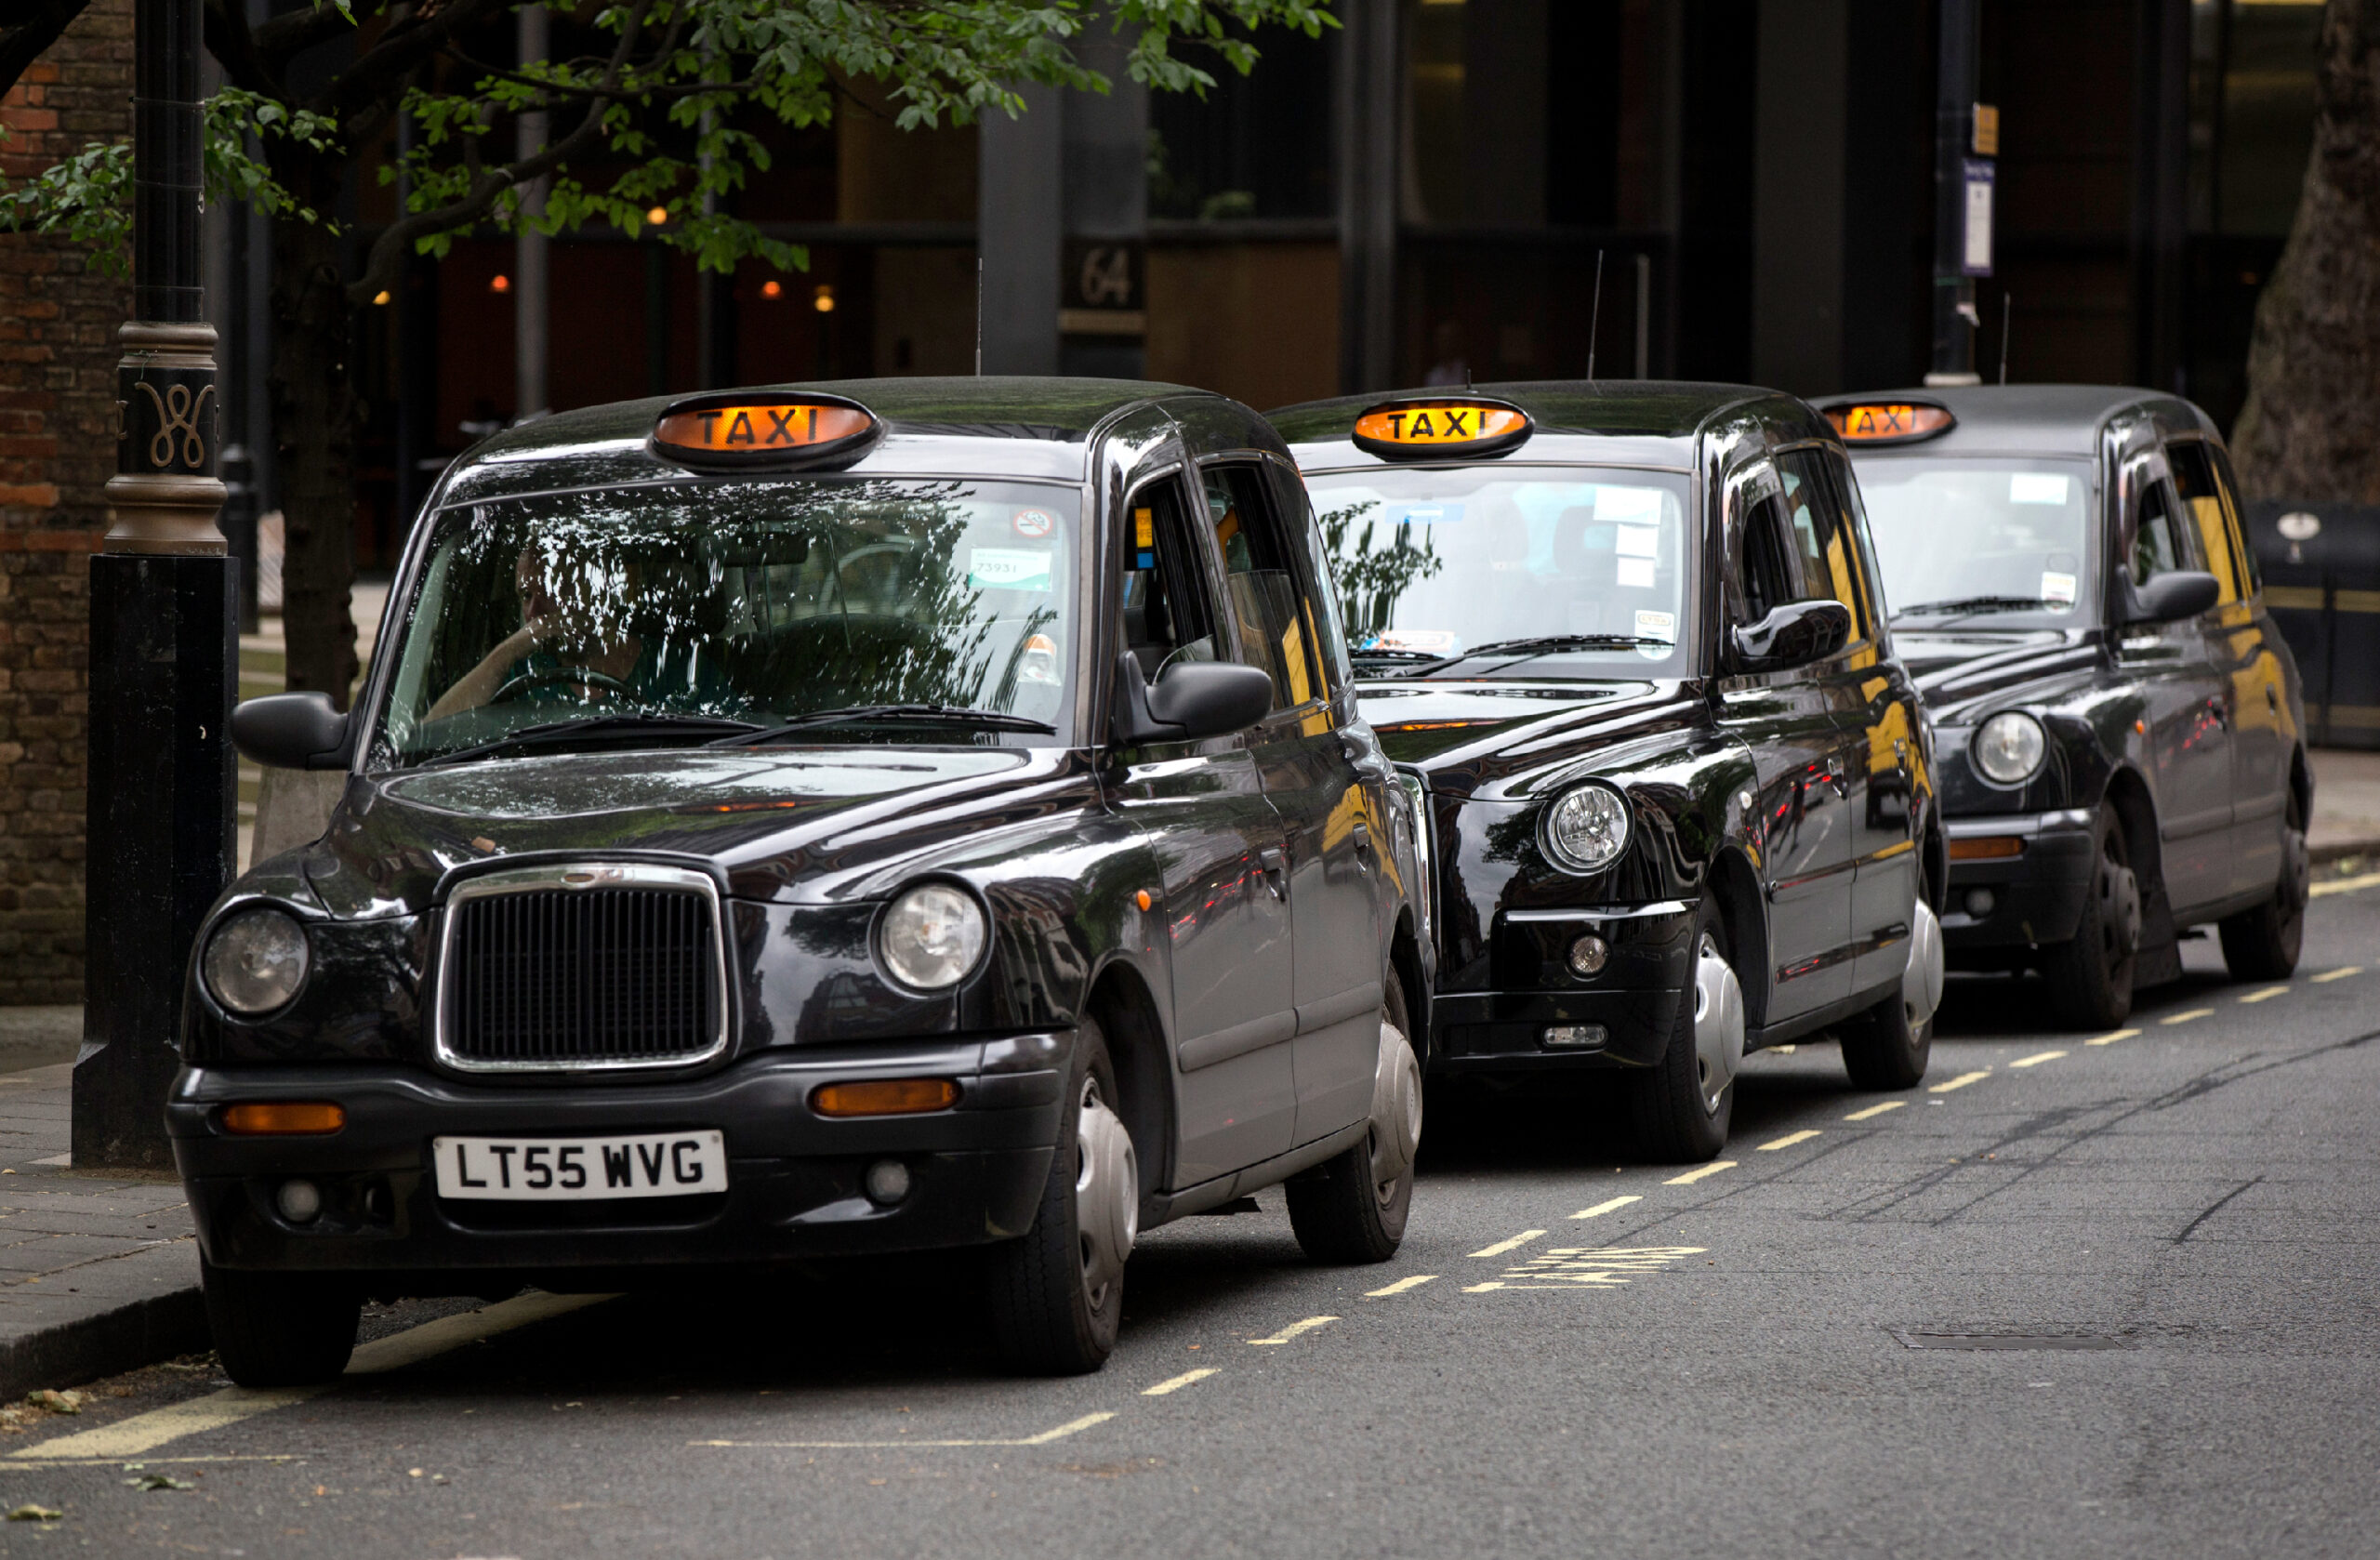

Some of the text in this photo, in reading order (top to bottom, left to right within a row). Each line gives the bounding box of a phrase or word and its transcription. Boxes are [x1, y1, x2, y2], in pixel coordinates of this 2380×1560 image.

[1082, 248, 1130, 304] 64
[697, 408, 818, 445] TAXI
[1388, 411, 1487, 440] TAXI
[1836, 406, 1917, 434] TAXI
[976, 562, 1017, 574] 73931
[456, 1141, 704, 1189] LT55 WVG
